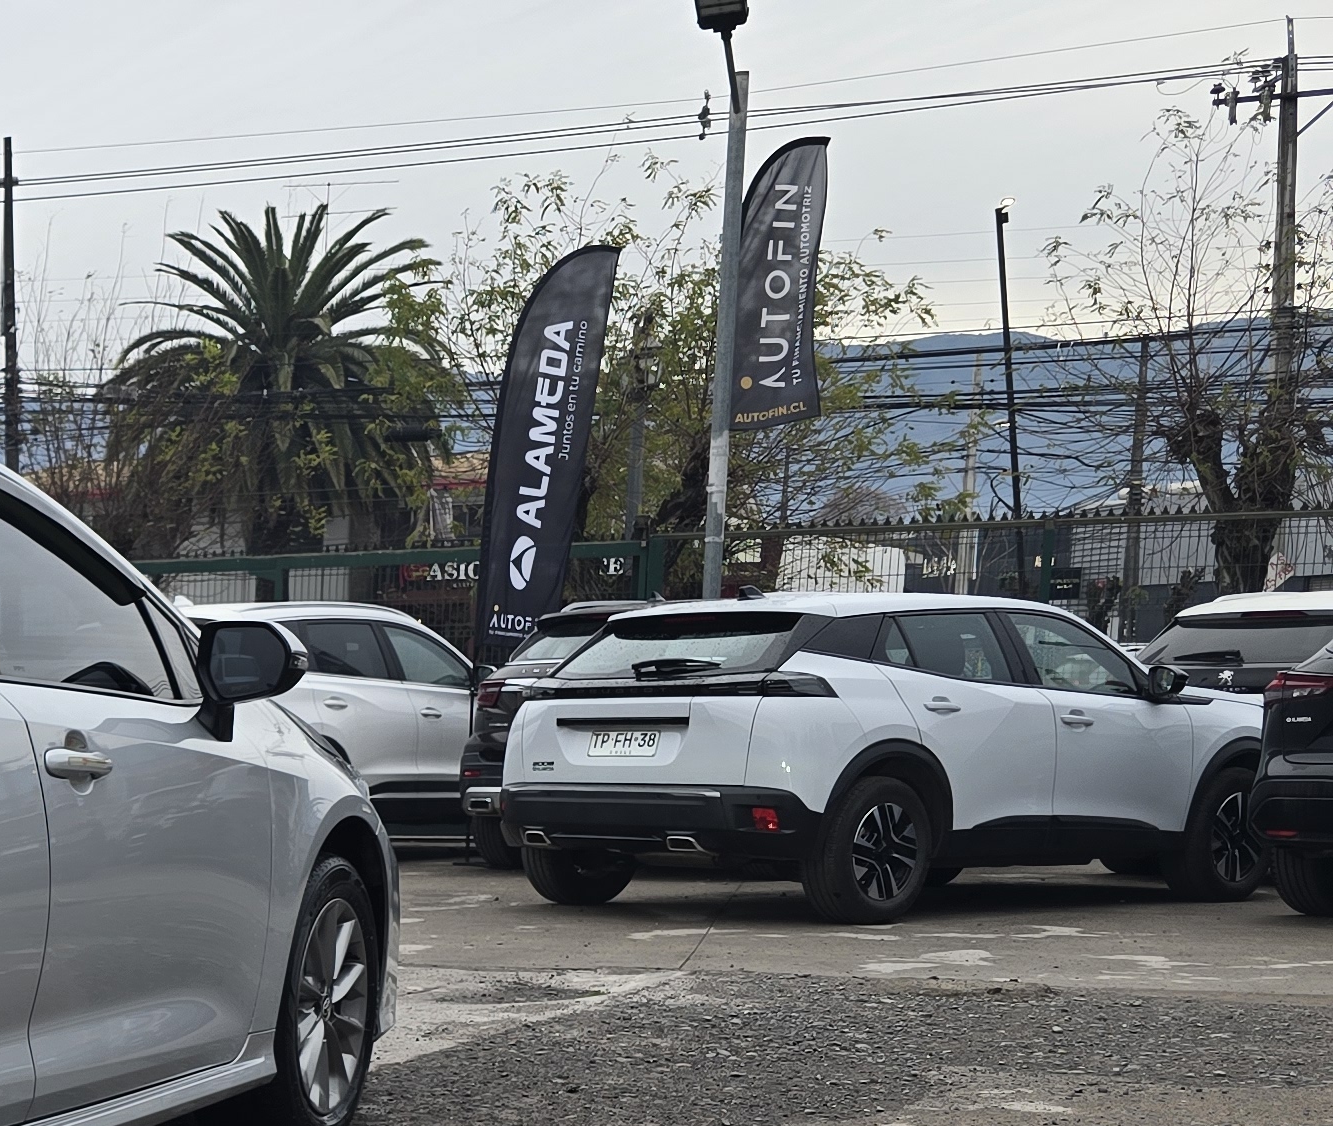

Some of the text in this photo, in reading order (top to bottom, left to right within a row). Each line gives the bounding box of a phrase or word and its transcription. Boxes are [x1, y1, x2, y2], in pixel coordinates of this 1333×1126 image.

[758, 184, 799, 388] AUTOFIN
[793, 368, 803, 386] TU
[799, 185, 813, 265] AUTOMOTRIZ
[516, 320, 574, 529] ALAMEDA
[558, 320, 588, 461] Juntos en tu camino
[734, 402, 808, 424] AUTOFIN.CL
